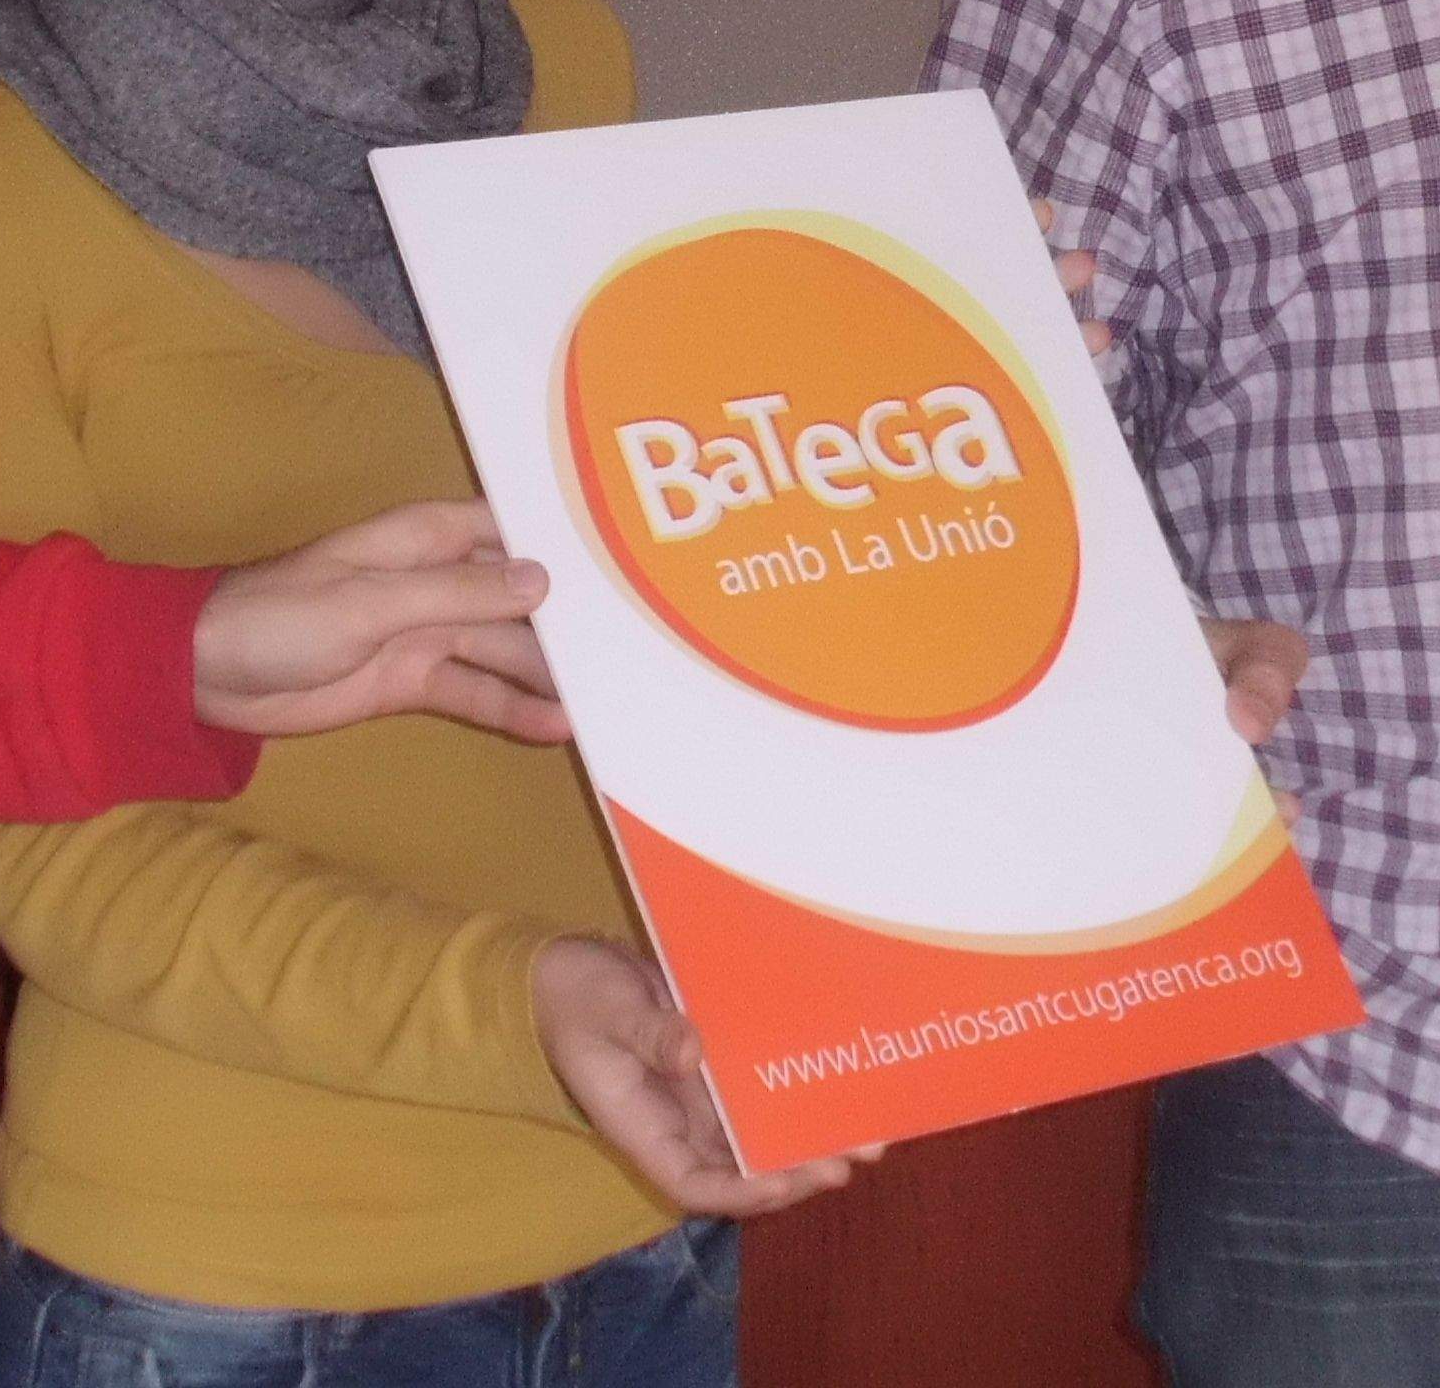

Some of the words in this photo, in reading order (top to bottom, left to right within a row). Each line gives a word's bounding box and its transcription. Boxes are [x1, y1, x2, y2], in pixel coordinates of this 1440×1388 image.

[615, 385, 1022, 542] BaTeGa
[715, 534, 827, 596] amb
[832, 529, 893, 575] La
[896, 502, 1015, 563] Unió
[754, 937, 1303, 1092] www.launiosantcugatenca.org
